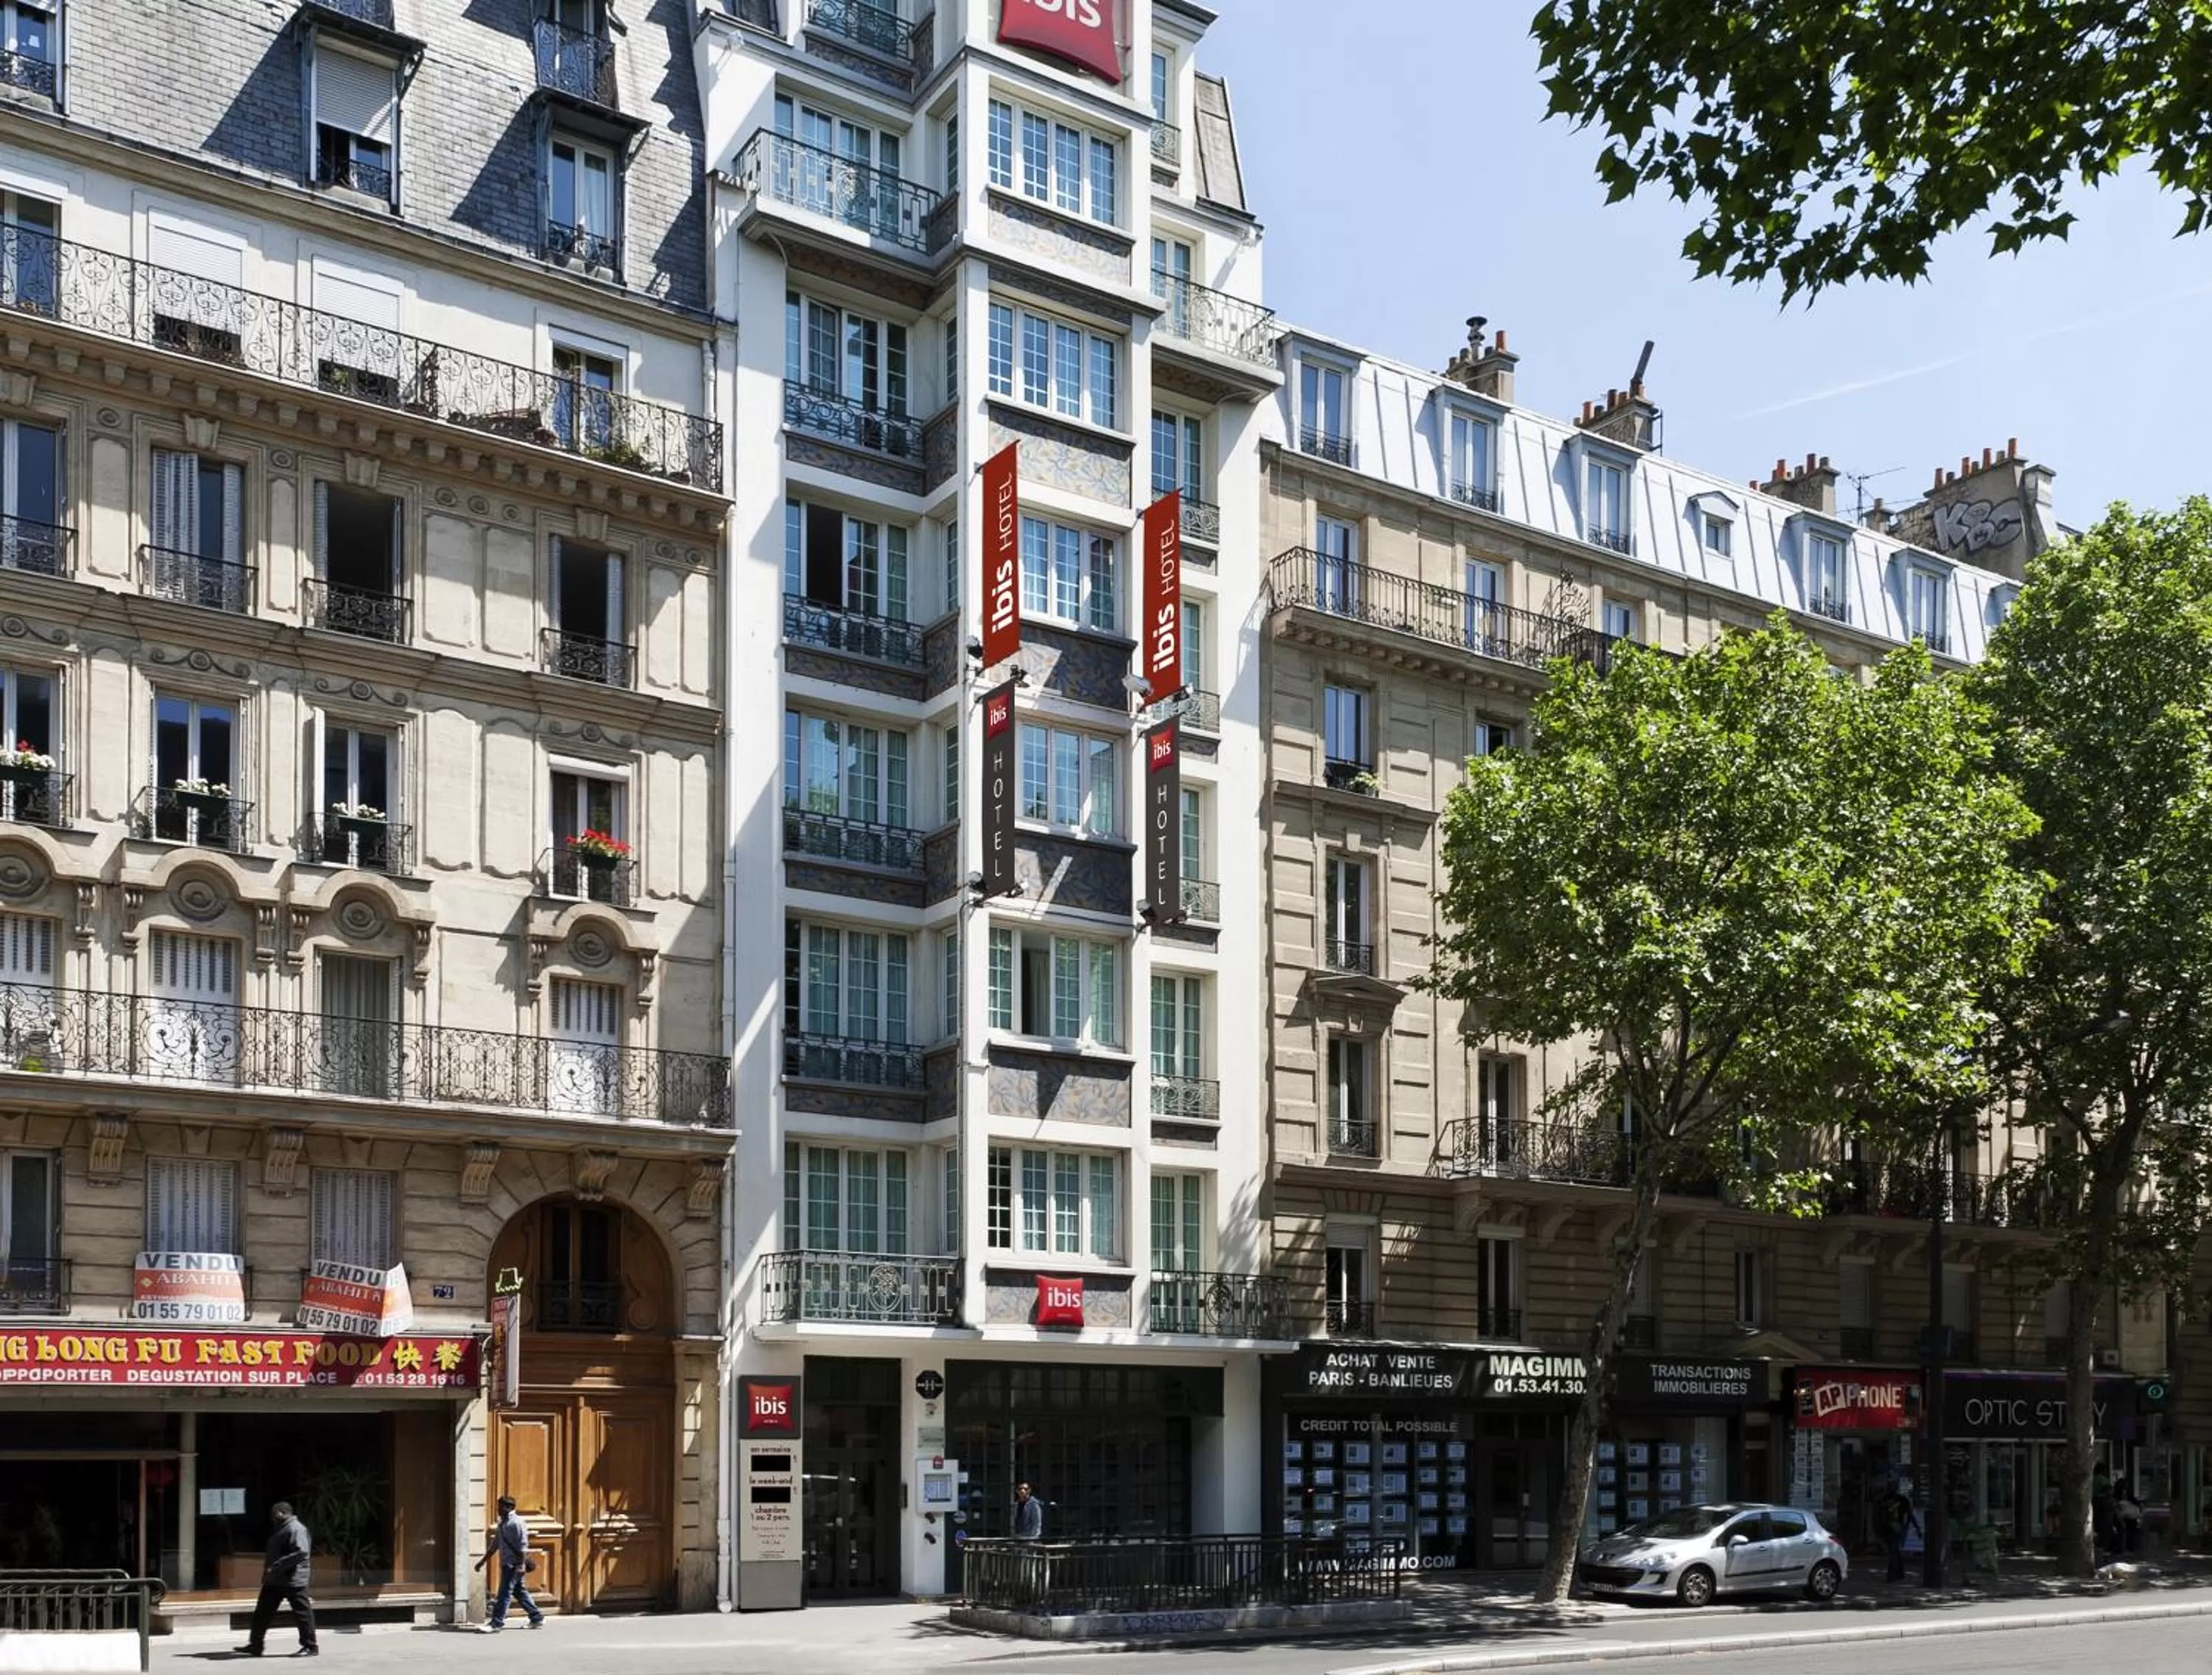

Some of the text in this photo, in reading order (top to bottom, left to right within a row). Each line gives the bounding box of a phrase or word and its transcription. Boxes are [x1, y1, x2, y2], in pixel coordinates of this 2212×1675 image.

[992, 472, 1013, 633] ibis HOTEL
[1153, 519, 1175, 673] ibis HOTEL
[990, 706, 1006, 726] ibis
[1153, 741, 1171, 760] ibis
[993, 750, 1003, 877] HOTEL
[1157, 784, 1167, 905] HOTEL
[145, 1253, 240, 1271] VENDU
[317, 1261, 381, 1286] VENDU
[1048, 1286, 1081, 1308] ibis
[138, 1302, 241, 1320] 01 55 79 01 02
[299, 1307, 310, 1322] 01
[310, 1309, 324, 1326] 55
[327, 1312, 341, 1328] 79
[343, 1315, 358, 1331] 01
[361, 1319, 378, 1335] 02
[135, 1338, 182, 1364] FU
[195, 1339, 285, 1365] FAST
[293, 1340, 382, 1365] FOOD
[393, 1340, 465, 1371] 快餐
[1326, 1353, 1436, 1369] ACHAT VENTE
[127, 1369, 243, 1382] DEGUSTATION
[248, 1371, 281, 1383] SUR
[286, 1371, 337, 1384] PLACE
[1489, 1355, 1587, 1377] MAGIMM
[1651, 1365, 1751, 1379] TRANSACTIONS
[1309, 1371, 1354, 1386] PARIS
[1368, 1373, 1453, 1388] BANLIEUES
[1494, 1379, 1587, 1393] 01.53.41.30.
[1654, 1380, 1747, 1394] IMMOBILIERES
[755, 1396, 787, 1414] ibis
[1846, 1385, 1902, 1408] PHONE
[1965, 1399, 2107, 1427] OPTIC STY
[1300, 1420, 1458, 1432] CREDIT TOTAL POSSIBLE
